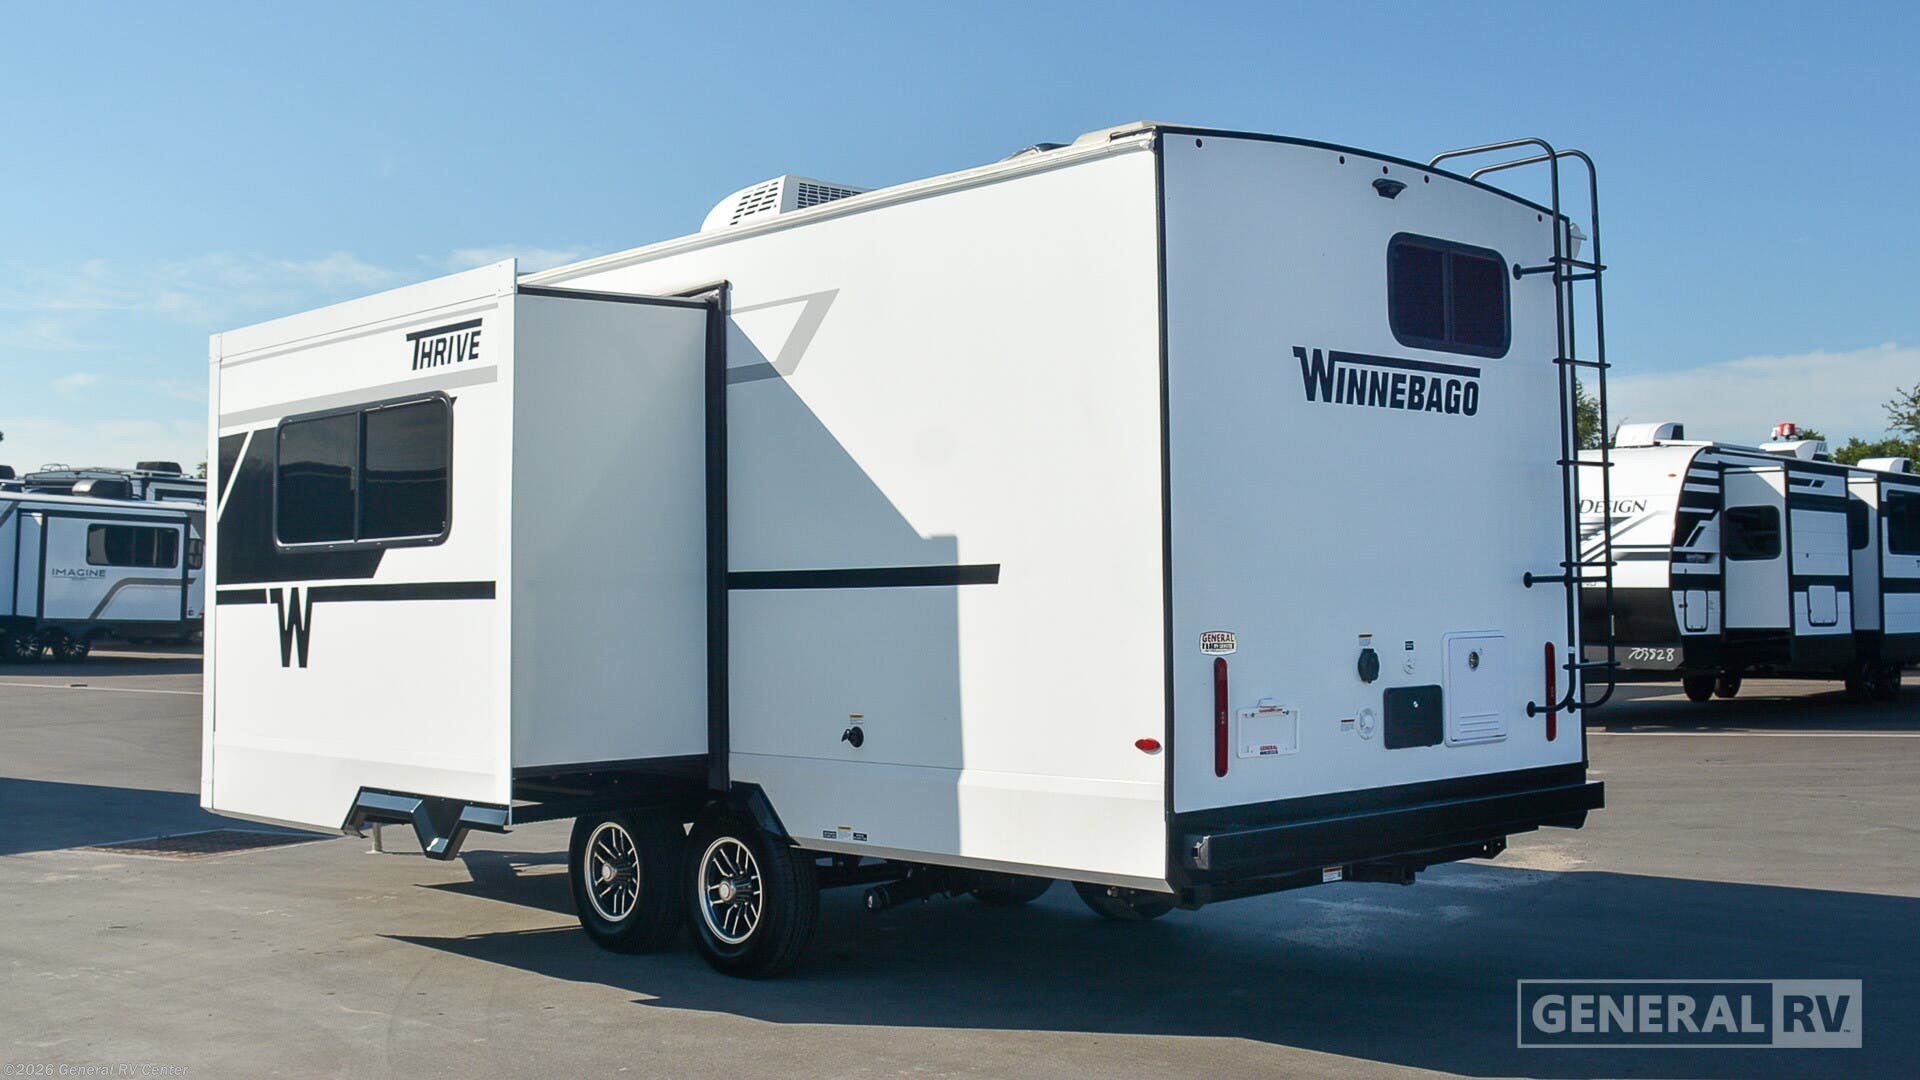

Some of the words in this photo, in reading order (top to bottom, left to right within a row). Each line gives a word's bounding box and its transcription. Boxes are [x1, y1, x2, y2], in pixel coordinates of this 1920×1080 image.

[406, 318, 483, 370] THRIVE
[1292, 346, 1481, 416] WINNEBAGO
[1580, 499, 1647, 514] DEIGN
[52, 568, 107, 577] IMAGINE
[1202, 633, 1234, 642] GENERAL
